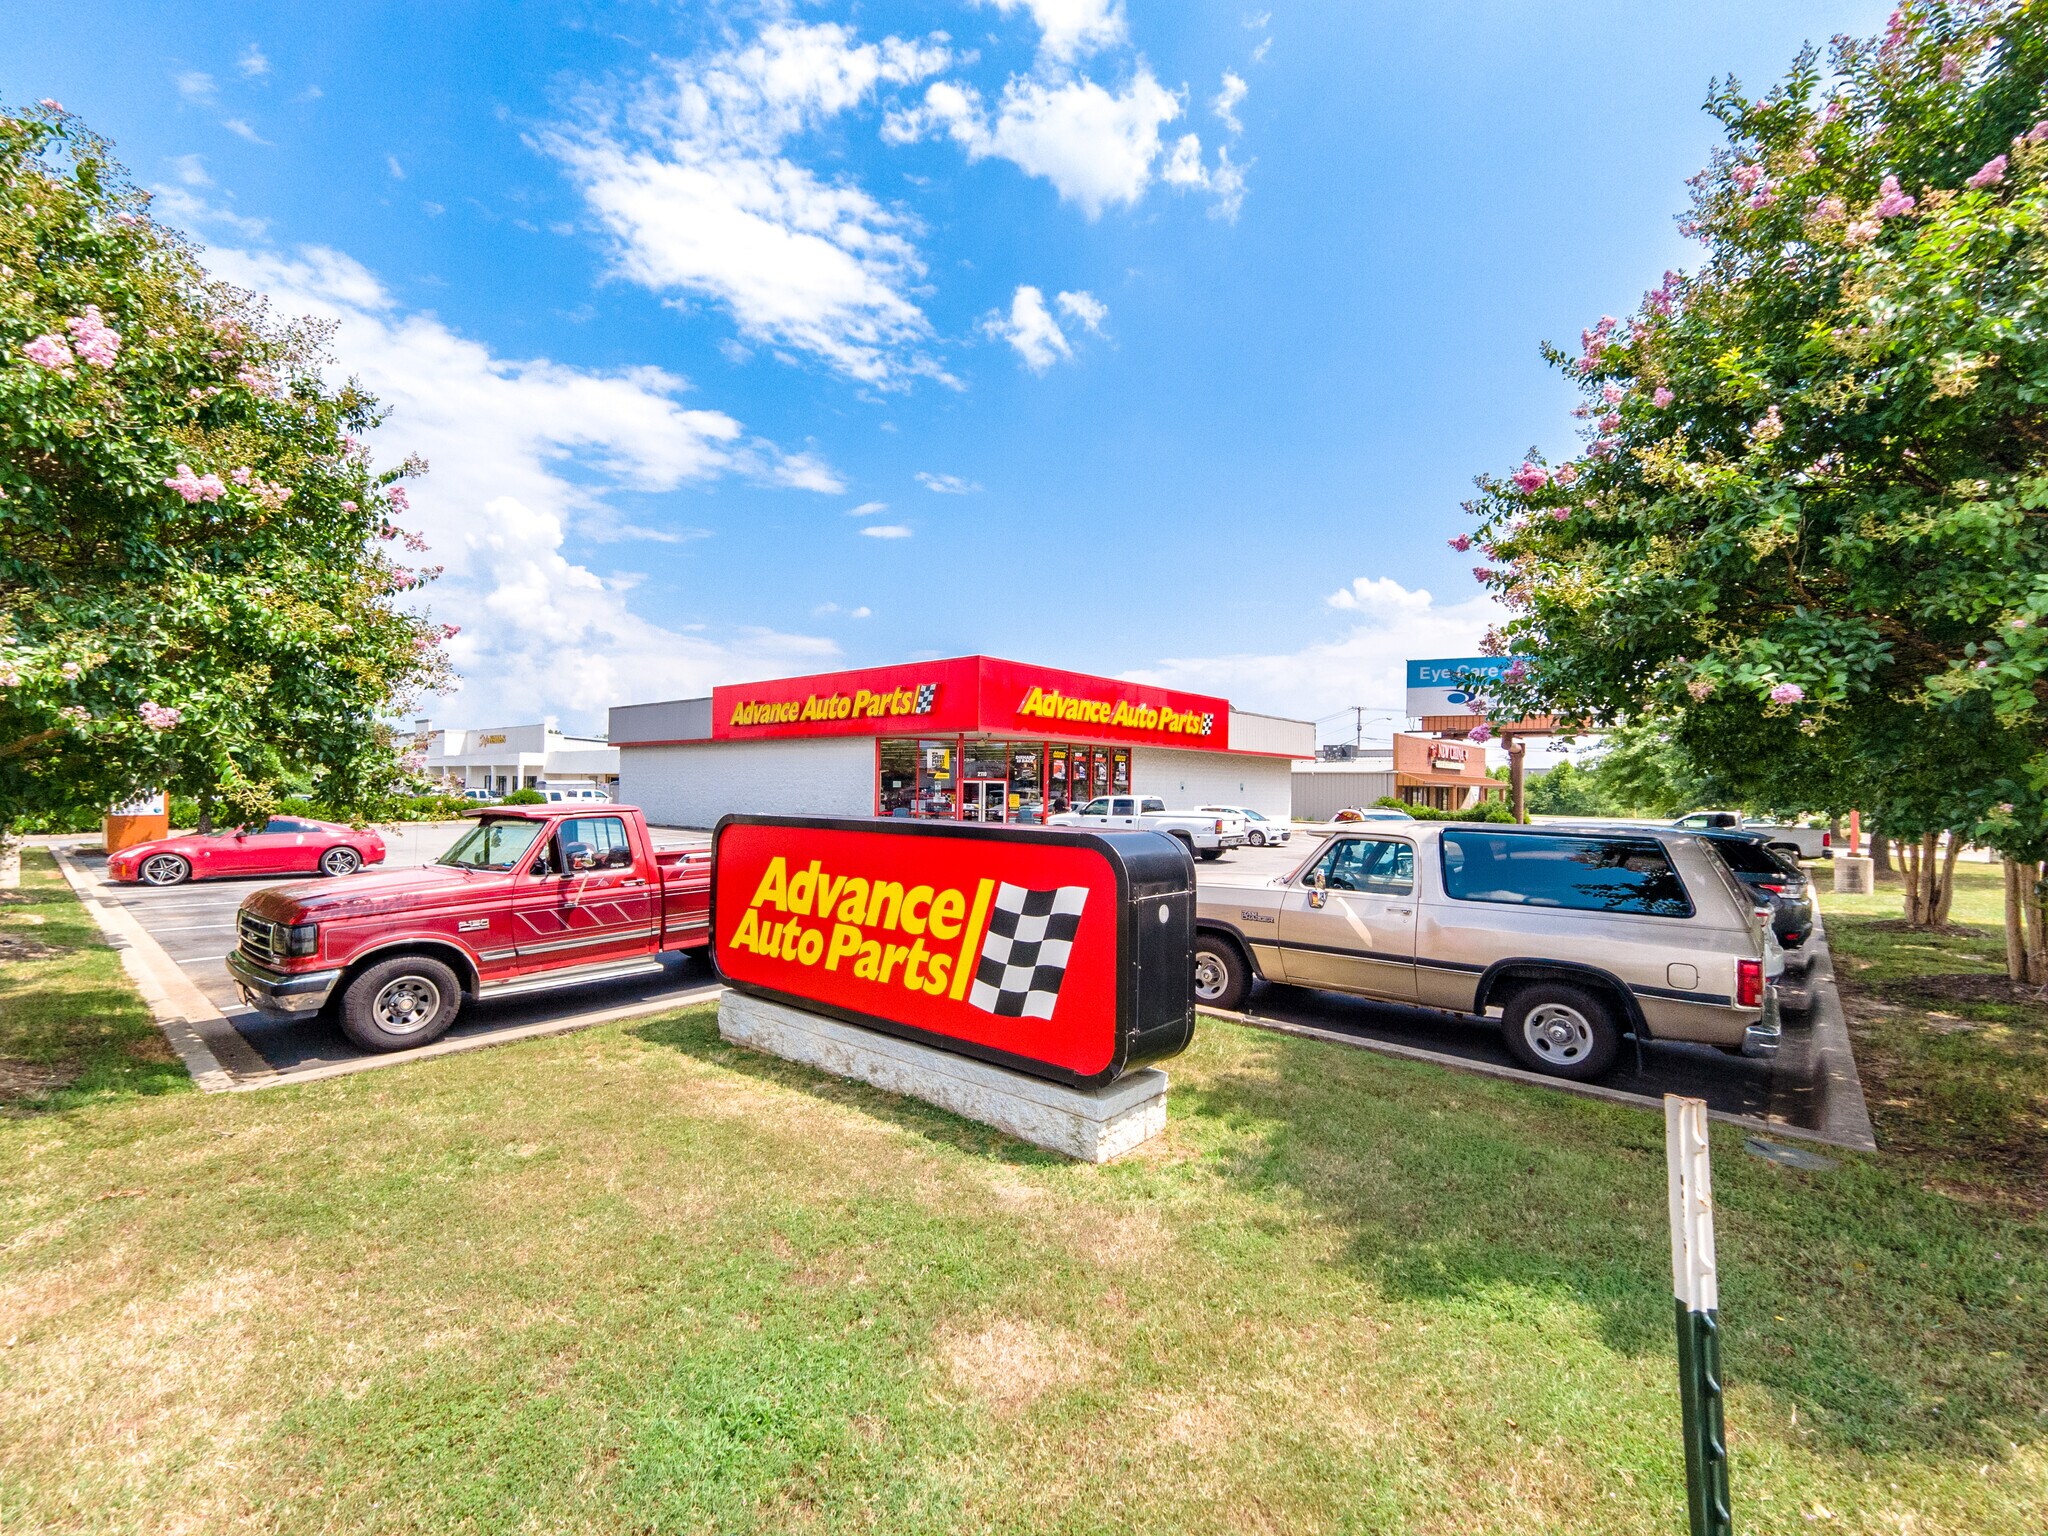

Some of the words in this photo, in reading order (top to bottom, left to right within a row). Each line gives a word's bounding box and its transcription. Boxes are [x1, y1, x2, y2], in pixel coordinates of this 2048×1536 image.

[1420, 666, 1451, 682] Eye
[1457, 664, 1499, 678] Care
[730, 701, 799, 725] Advance
[800, 692, 851, 721] Auto
[852, 686, 912, 717] Parts
[1021, 687, 1111, 723] Advance
[1111, 700, 1158, 730] Auto
[1158, 707, 1201, 735] Parts
[751, 857, 966, 940] Advance
[730, 909, 823, 965] Auto
[825, 924, 951, 996] Parts
